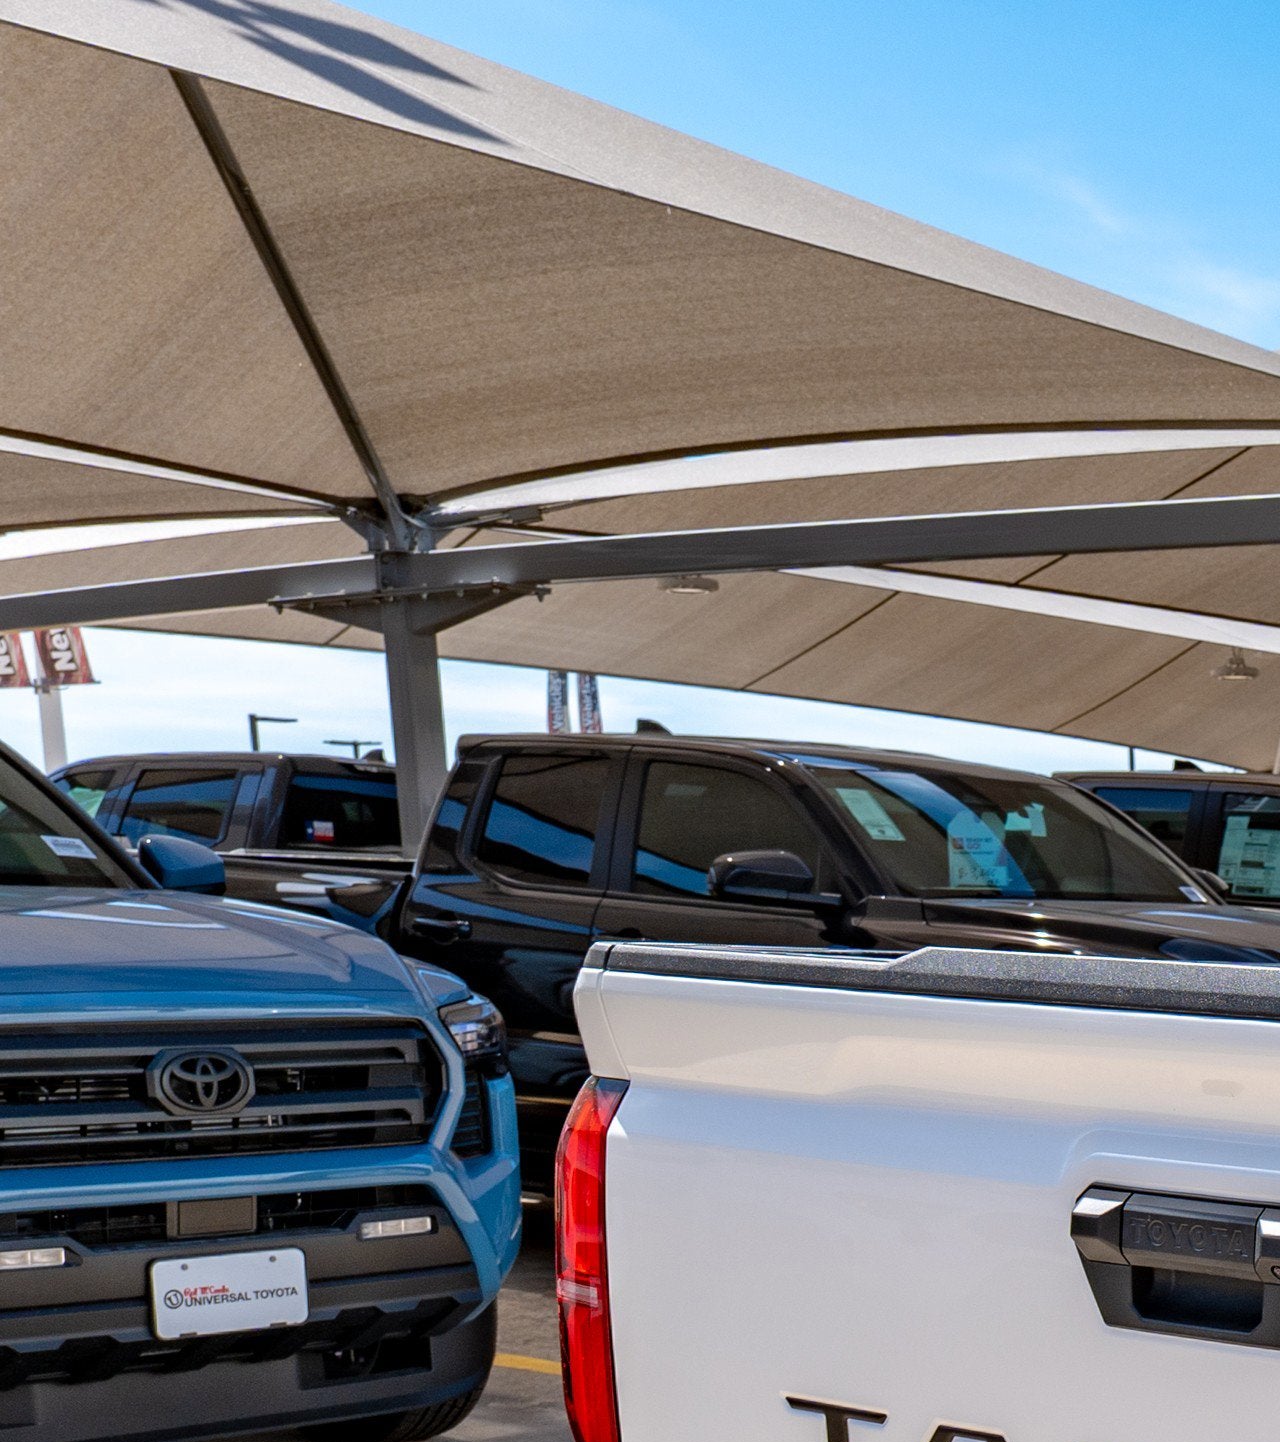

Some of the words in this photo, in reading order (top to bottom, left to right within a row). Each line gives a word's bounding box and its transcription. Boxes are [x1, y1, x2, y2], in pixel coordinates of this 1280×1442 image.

[49, 628, 78, 672] Ne
[1130, 1215, 1249, 1259] TOYOTA
[185, 1292, 252, 1308] UNIVERSAL
[253, 1287, 298, 1300] TOYOTA
